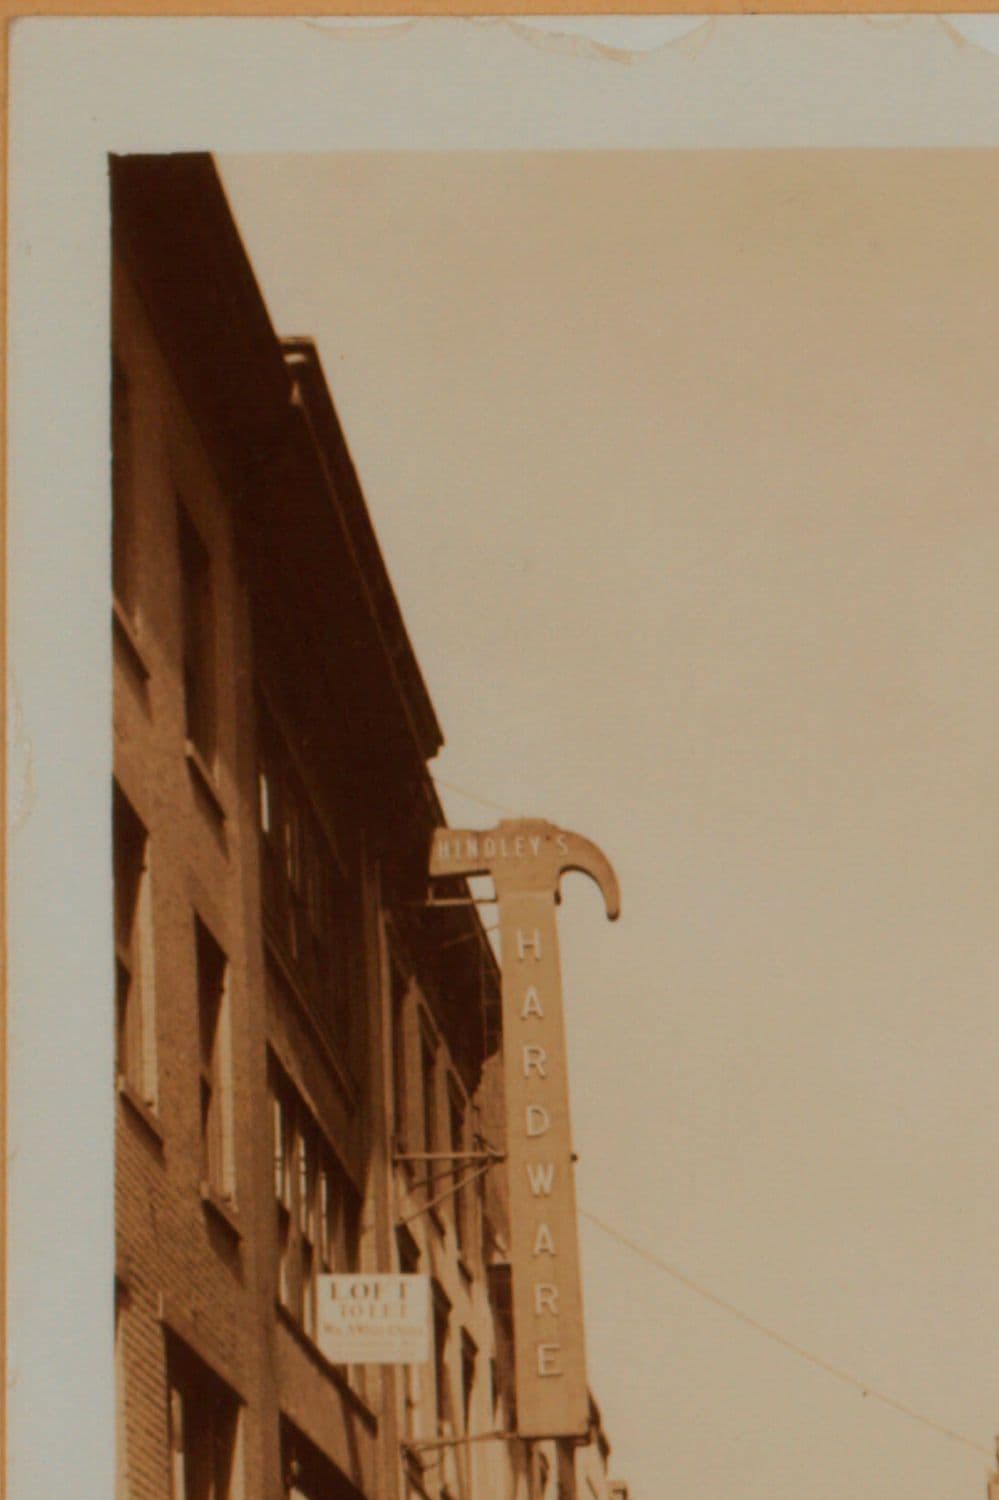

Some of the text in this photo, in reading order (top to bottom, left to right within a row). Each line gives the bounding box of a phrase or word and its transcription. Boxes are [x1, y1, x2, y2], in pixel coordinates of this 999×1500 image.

[438, 834, 569, 859] HINDLEY'S
[516, 928, 564, 1378] HARDWARE
[330, 1282, 411, 1301] LOFT
